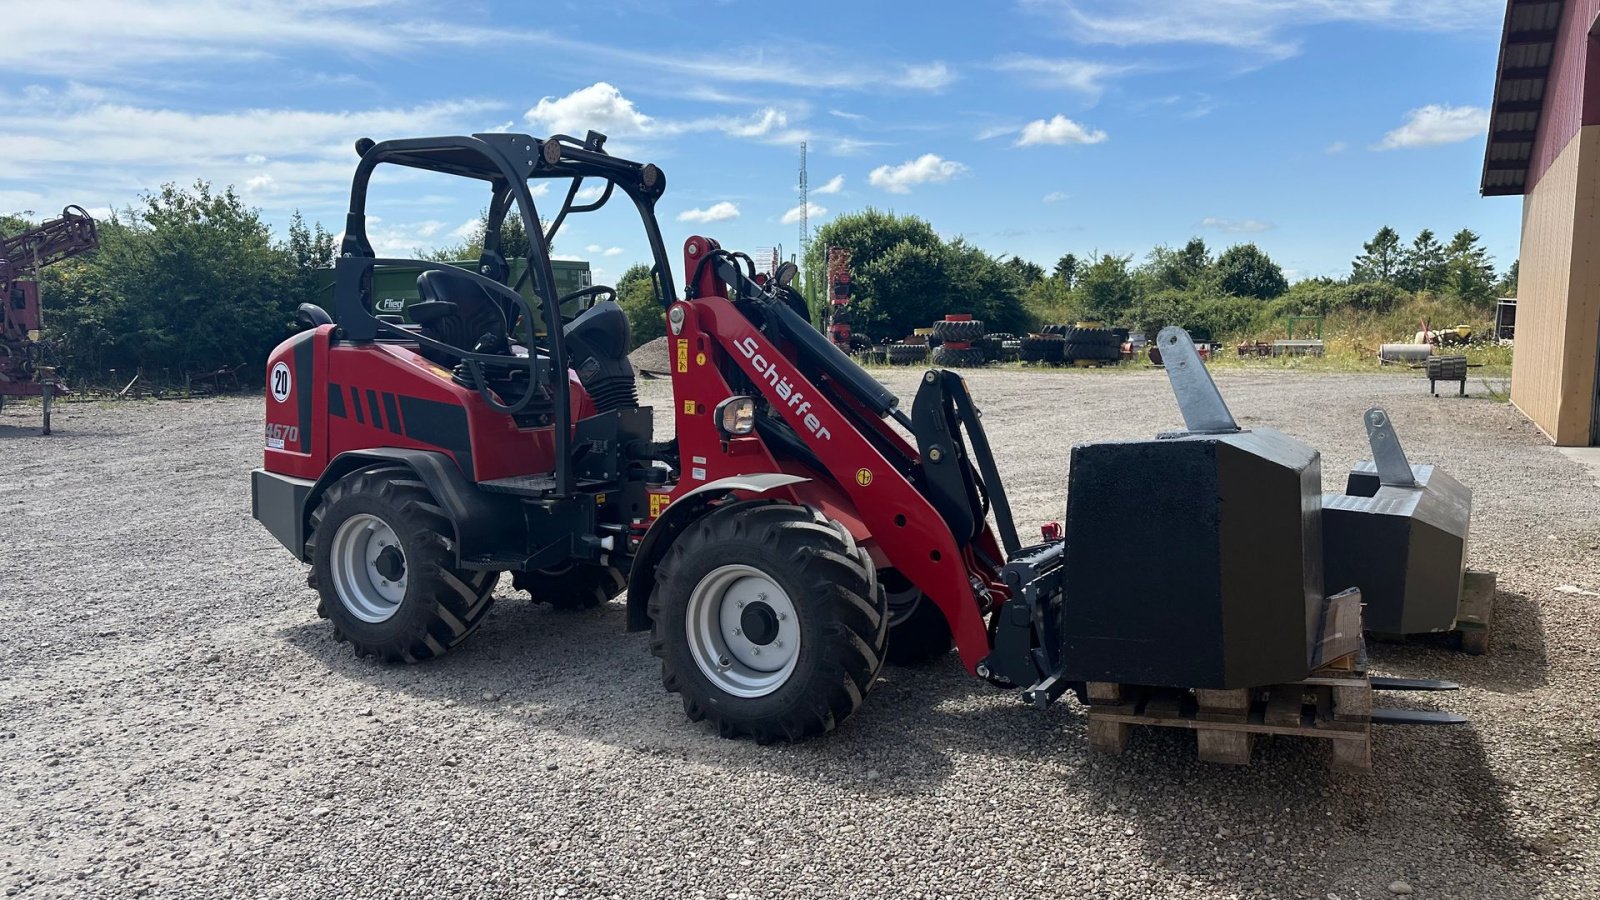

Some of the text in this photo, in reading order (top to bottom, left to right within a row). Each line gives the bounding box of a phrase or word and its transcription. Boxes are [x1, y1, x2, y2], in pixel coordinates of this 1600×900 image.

[384, 298, 405, 310] Fliegl
[275, 369, 288, 396] 20
[733, 337, 831, 440] Schäffer
[265, 423, 299, 442] 4670
